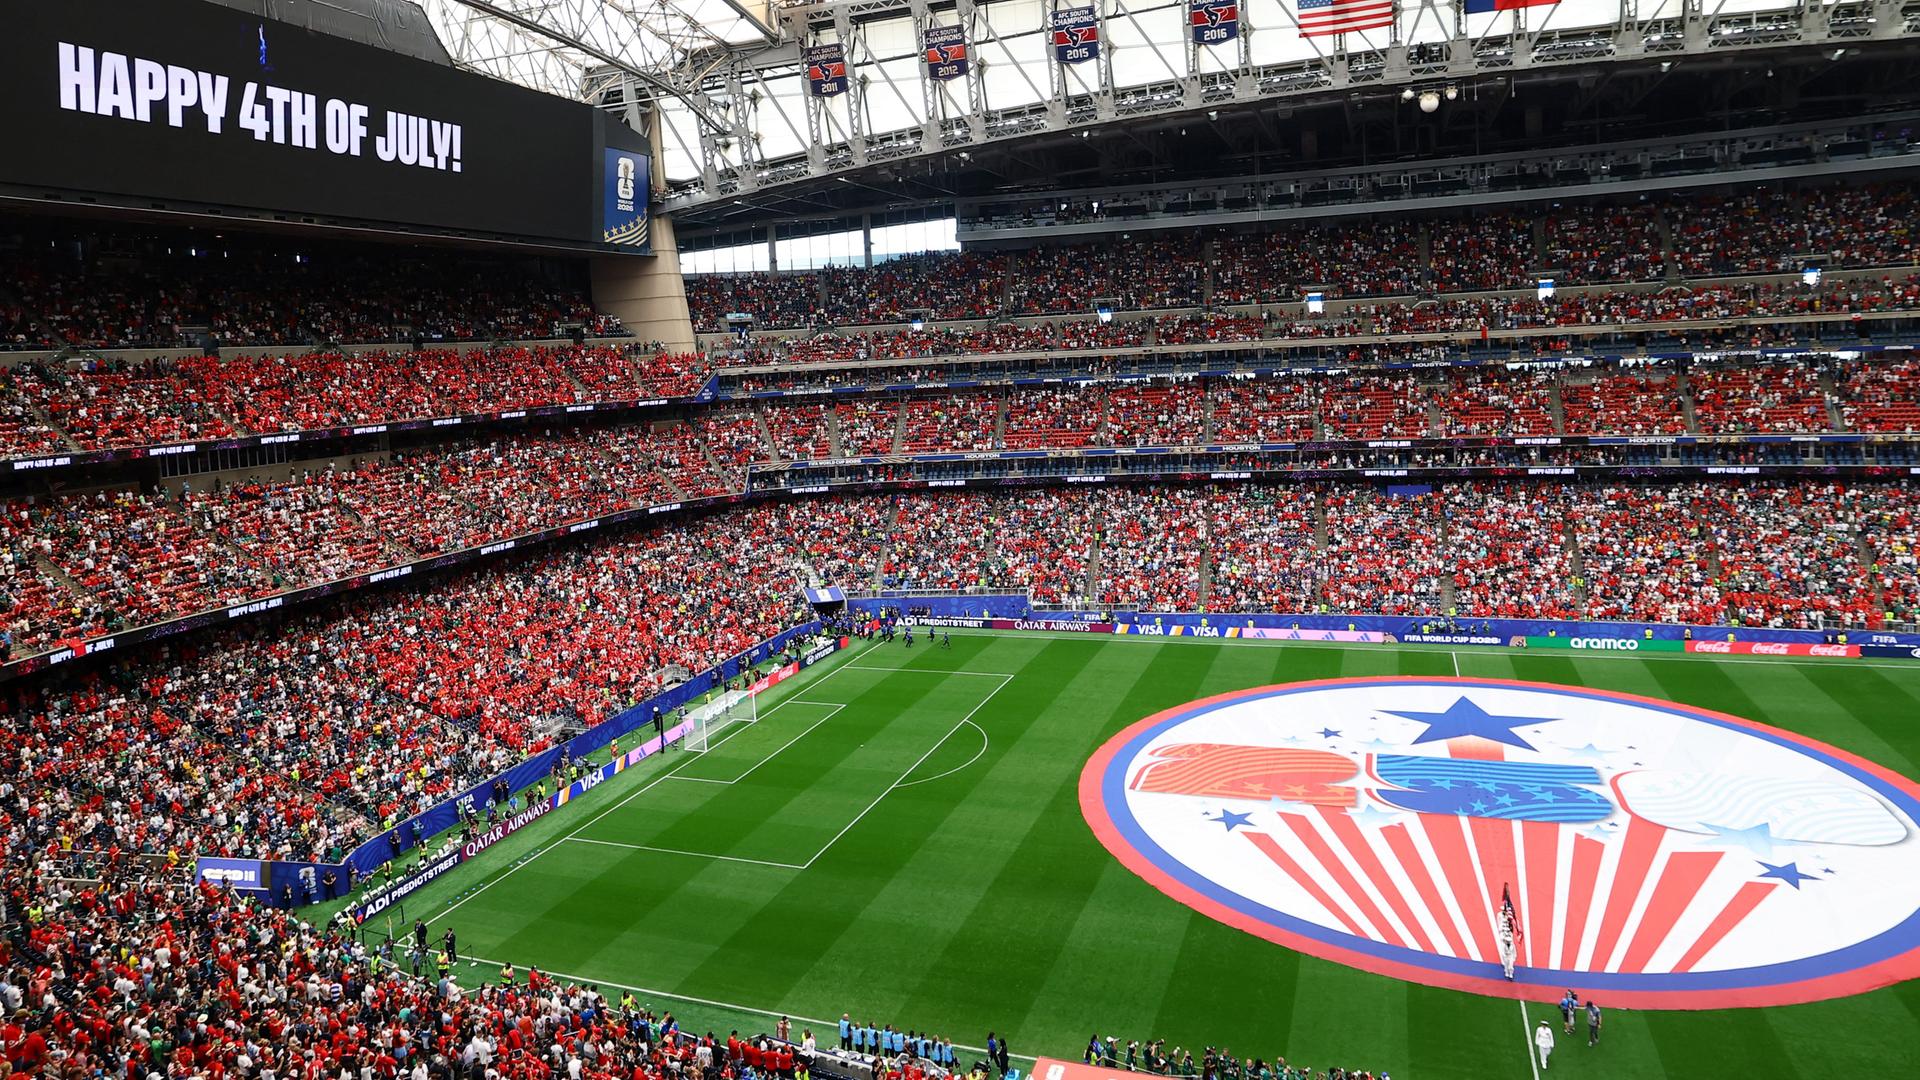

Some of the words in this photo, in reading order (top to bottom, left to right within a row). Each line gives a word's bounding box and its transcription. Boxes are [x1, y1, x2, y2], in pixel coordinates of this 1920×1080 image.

[1054, 14, 1094, 27] CHAMPIONS
[926, 33, 962, 45] CHAMPIONS
[1203, 28, 1228, 41] 2016
[1066, 47, 1089, 60] 2015
[937, 64, 959, 77] 2012
[821, 81, 839, 94] 2011
[58, 41, 229, 133] HAPPY
[238, 81, 317, 149] 4TH
[325, 99, 368, 156] OF
[375, 111, 463, 173] JULY!
[895, 618, 918, 627] ADI
[1014, 621, 1046, 631] QATAR
[1050, 621, 1091, 632] AIRWAYS
[1136, 624, 1164, 635] VISA
[1190, 626, 1219, 637] VISA
[1404, 634, 1422, 642] FIFA
[1422, 635, 1452, 643] WORLD
[1570, 637, 1638, 650] aramco
[1872, 635, 1898, 644] FIFA
[1694, 640, 1732, 653] Coca-Cola
[1751, 642, 1789, 655] Coca-Cola
[1809, 644, 1848, 656] Coca-Cola
[579, 768, 605, 792] VISA
[465, 825, 504, 857] QATAR
[506, 799, 550, 834] AIRWAYS
[365, 894, 390, 919] ADI
[391, 853, 459, 902] PREDICTSTREET
